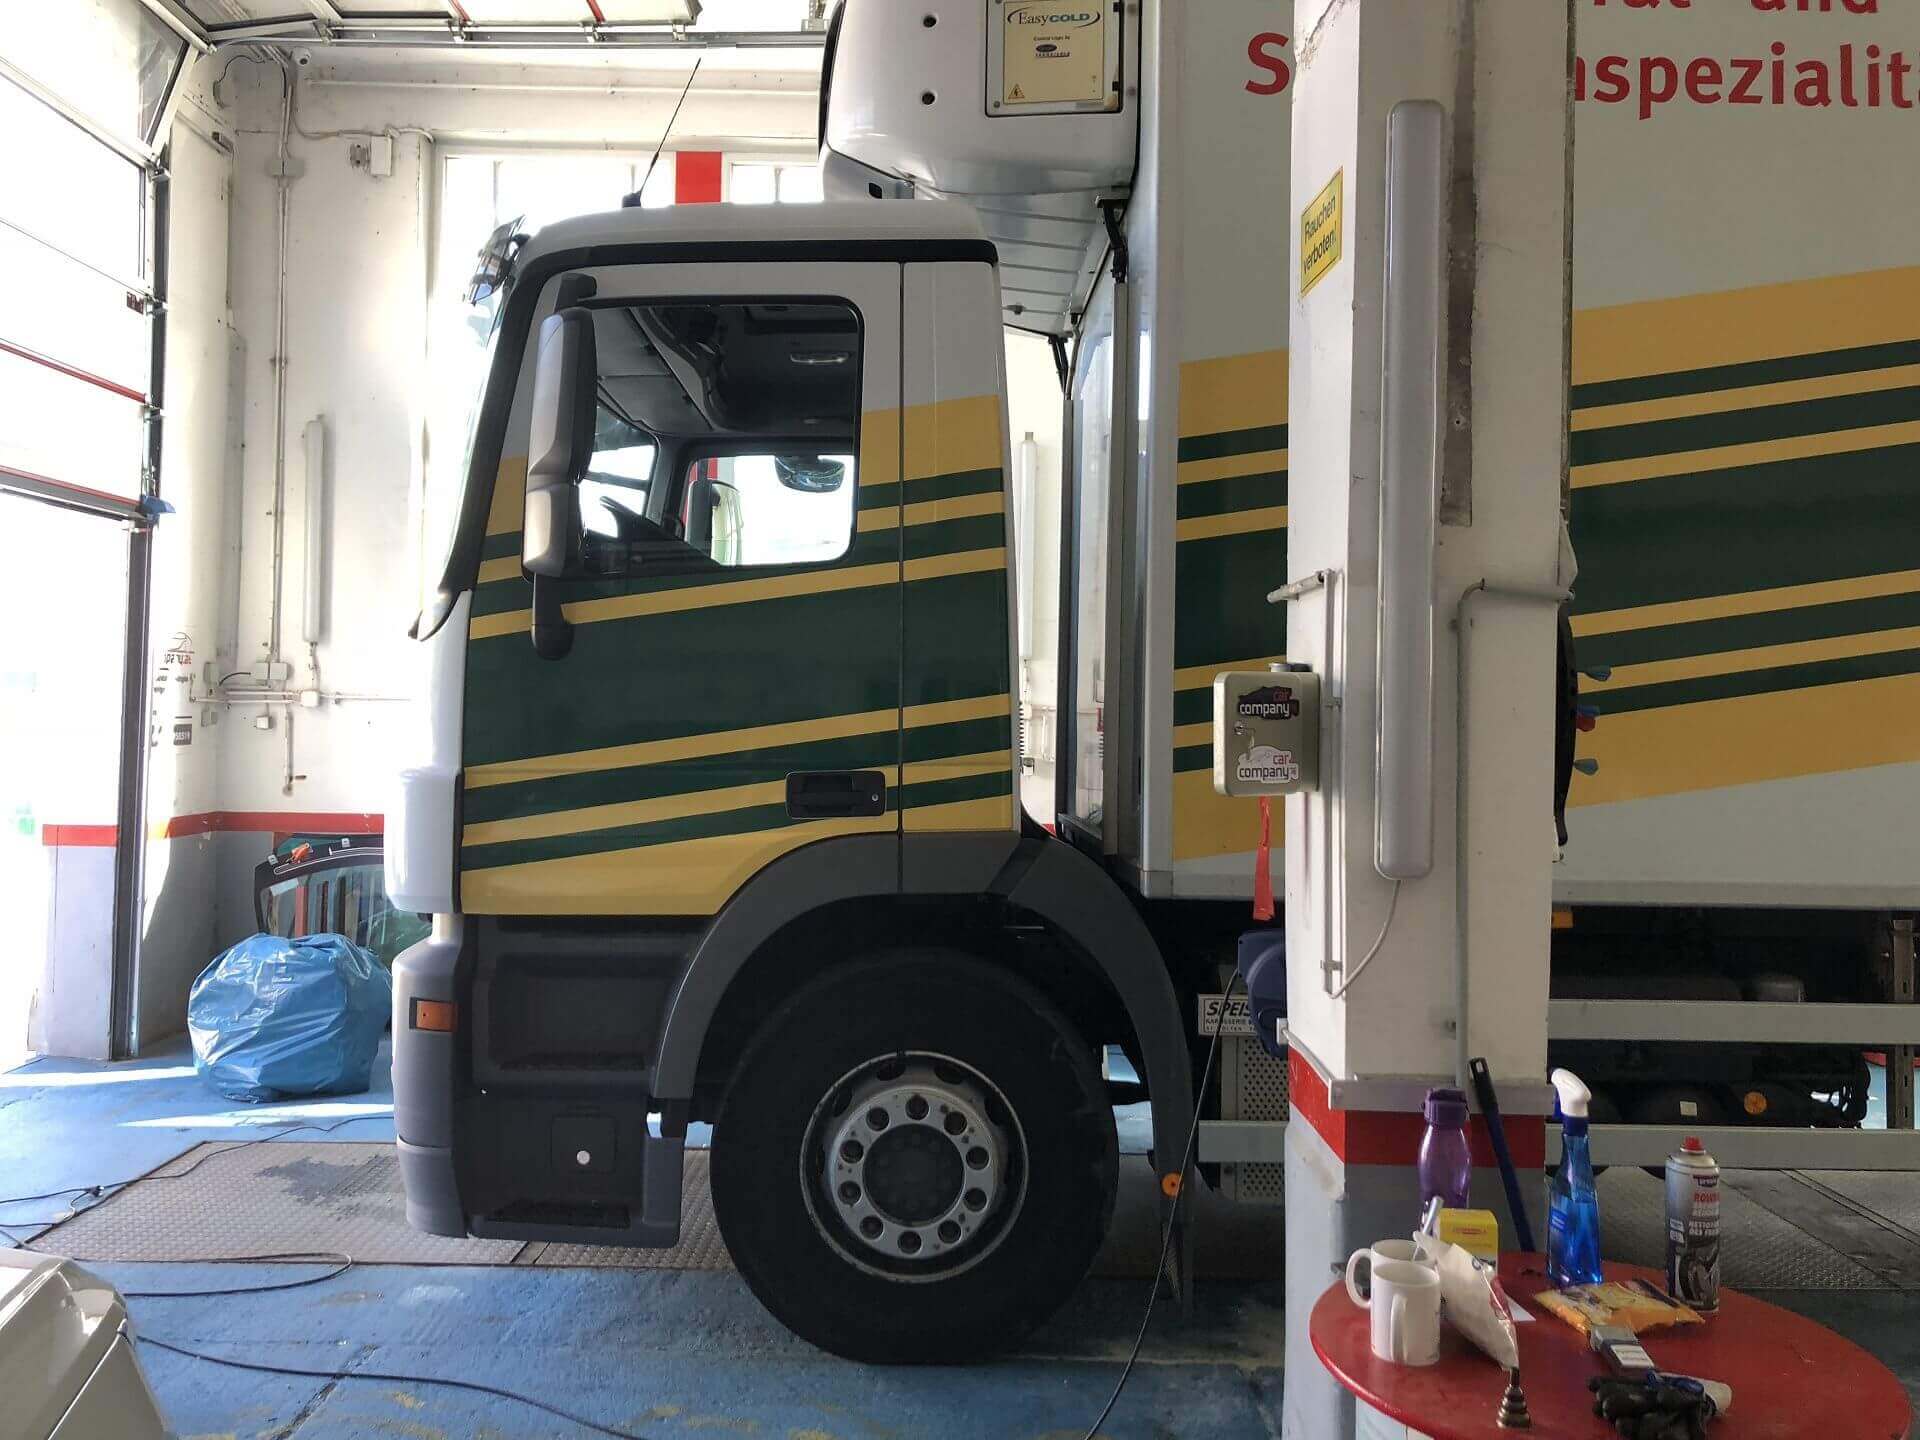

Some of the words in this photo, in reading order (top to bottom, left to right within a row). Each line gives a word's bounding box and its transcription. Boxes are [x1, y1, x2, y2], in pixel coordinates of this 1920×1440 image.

[1018, 12, 1091, 26] EasyCOLD
[1575, 41, 1920, 120] spezialit
[1304, 194, 1336, 243] Rauchen
[1303, 220, 1337, 274] verboten!
[1273, 688, 1290, 702] car
[1239, 703, 1290, 718] company
[1273, 753, 1290, 765] car
[1239, 766, 1290, 781] company
